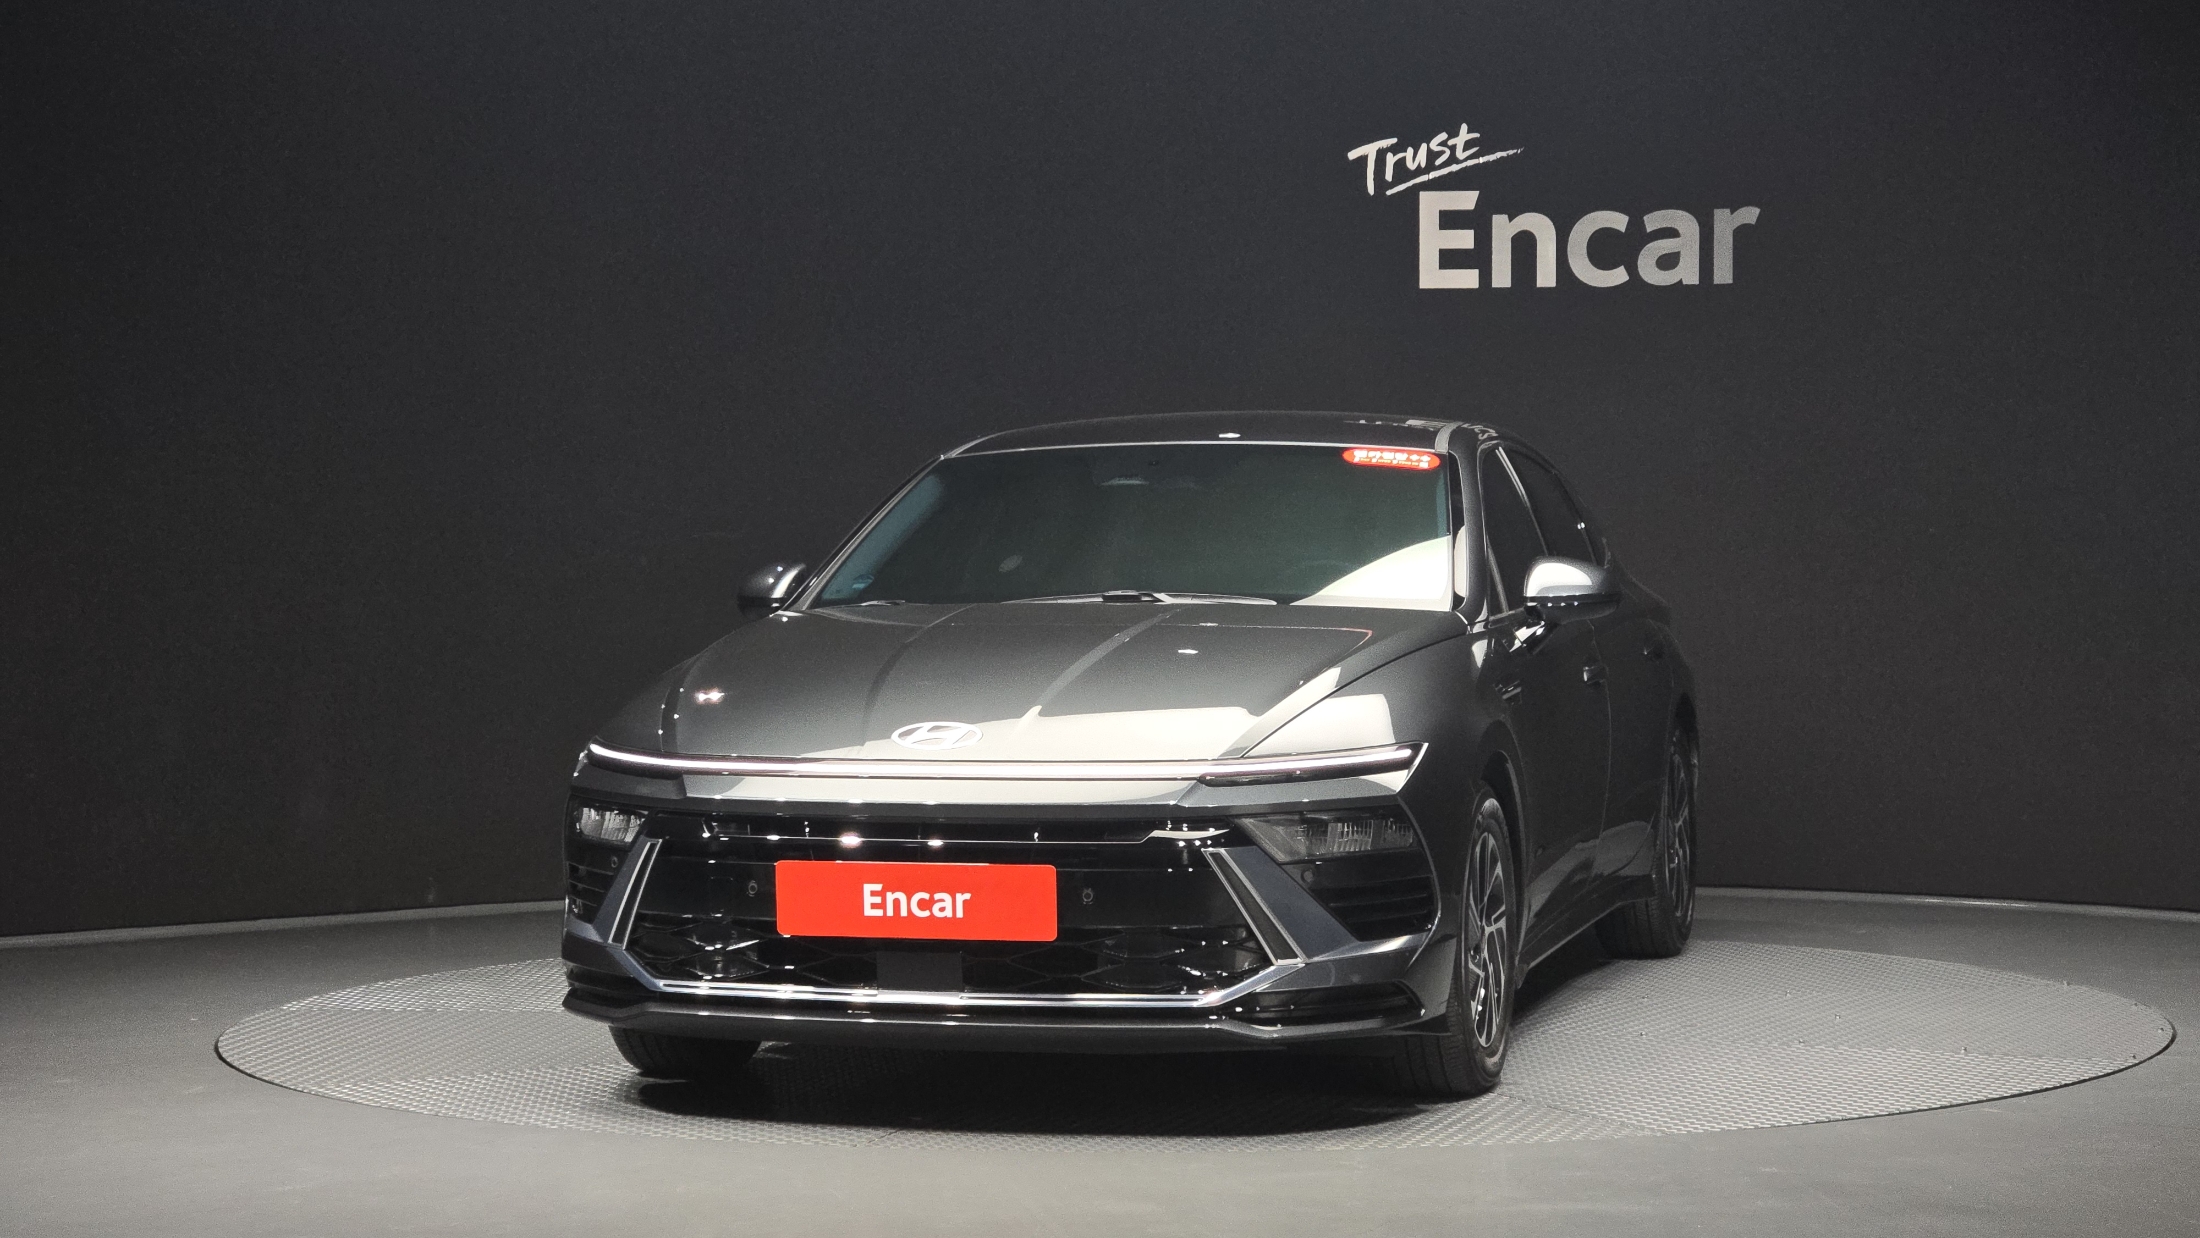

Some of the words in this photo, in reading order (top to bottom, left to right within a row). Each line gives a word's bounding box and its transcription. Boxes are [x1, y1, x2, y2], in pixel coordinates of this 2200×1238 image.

[1347, 122, 1481, 197] Trust
[1418, 190, 1761, 290] Encar
[862, 883, 972, 919] Encar
